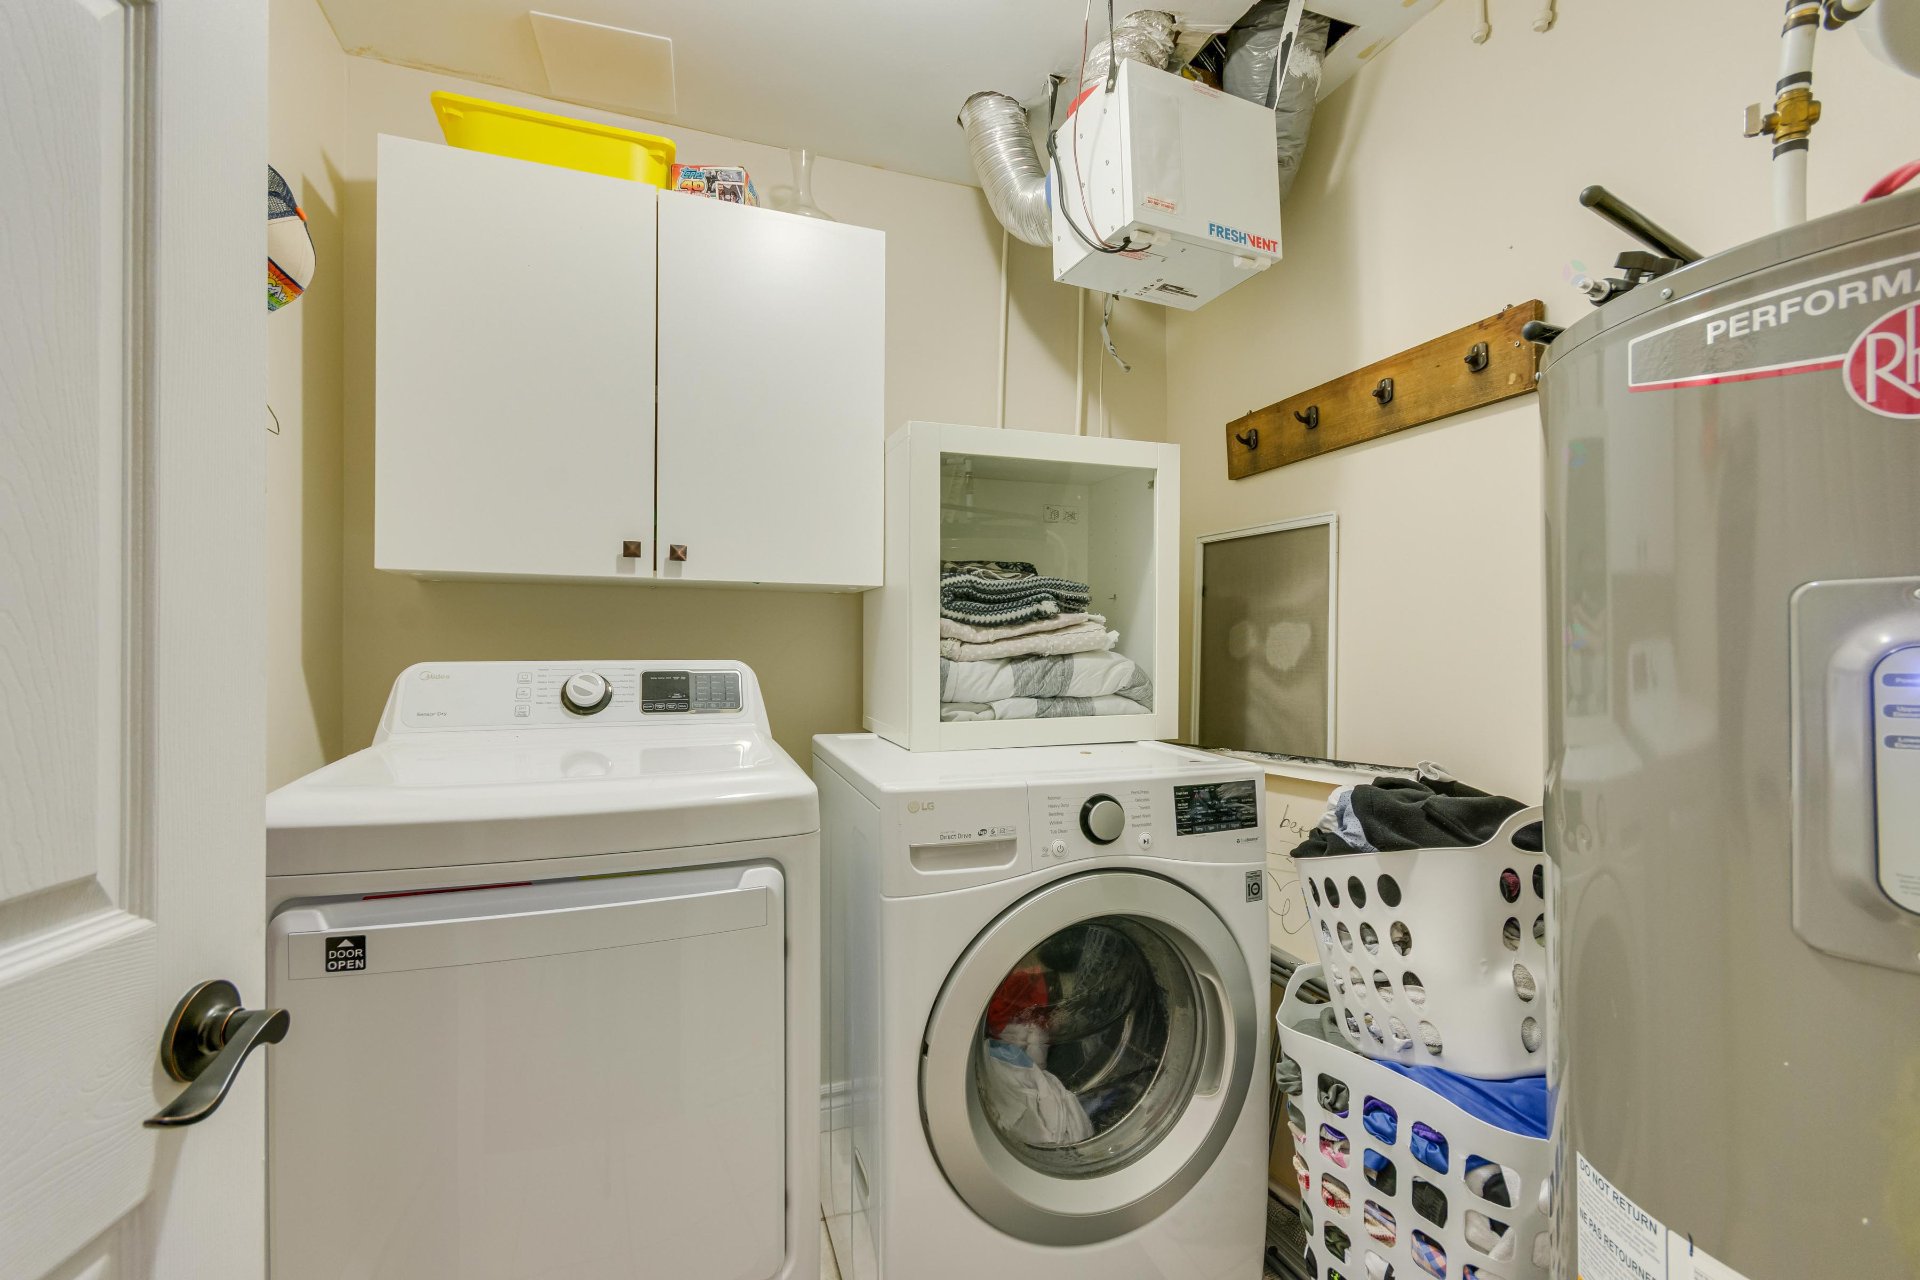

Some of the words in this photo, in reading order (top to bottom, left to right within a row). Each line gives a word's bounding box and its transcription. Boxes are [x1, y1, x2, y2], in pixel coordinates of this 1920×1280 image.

[1208, 223, 1278, 252] FRESHVENT
[1706, 268, 1920, 345] PERFORM
[921, 802, 935, 811] LG
[327, 959, 364, 970] OPEN
[328, 948, 363, 959] DOOR
[1580, 1159, 1590, 1177] DO
[1592, 1171, 1610, 1195] NOT
[1612, 1191, 1658, 1235] RETURN
[1579, 1207, 1587, 1225] NE
[1589, 1218, 1602, 1240] PAS
